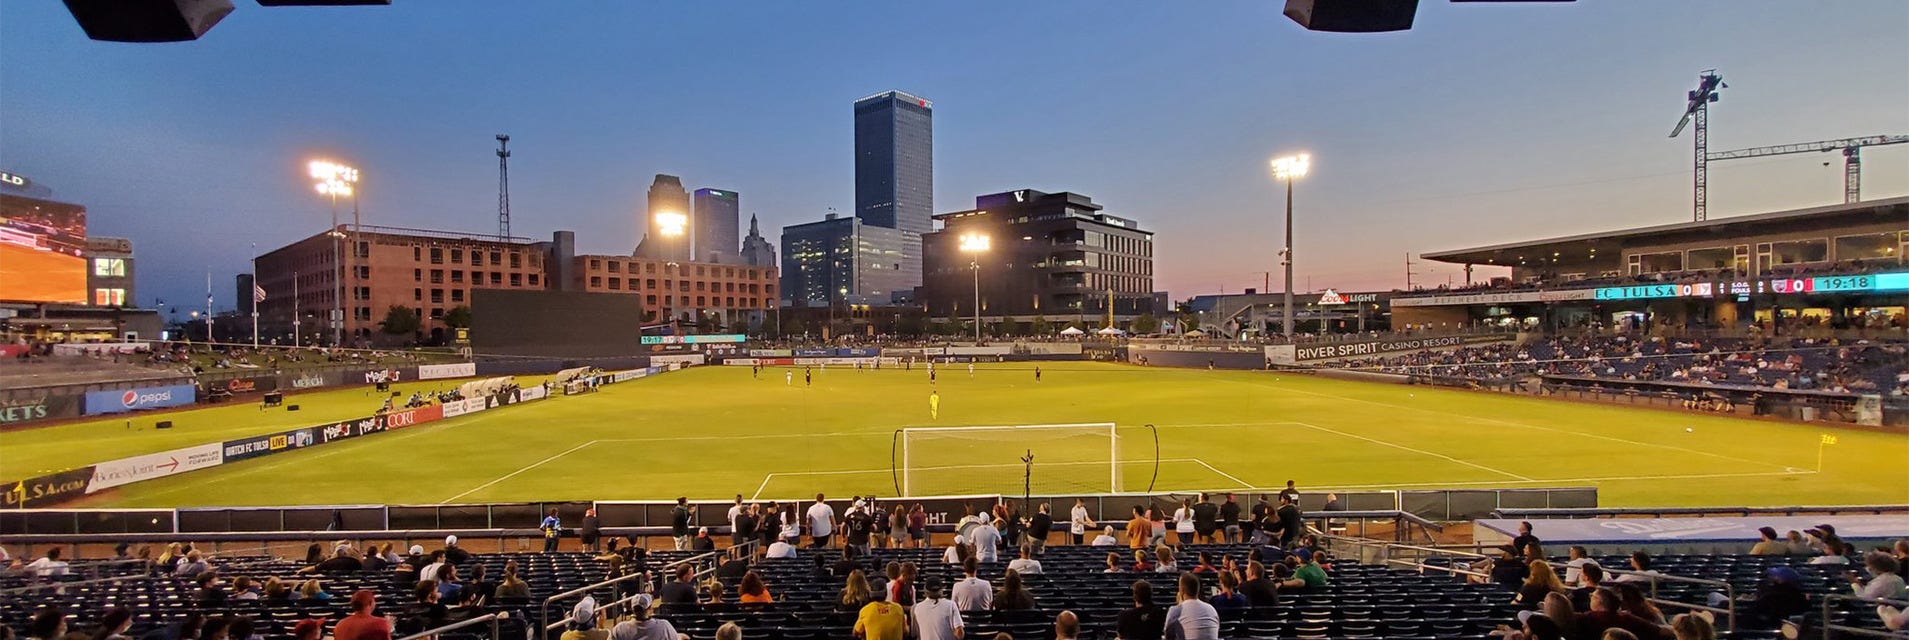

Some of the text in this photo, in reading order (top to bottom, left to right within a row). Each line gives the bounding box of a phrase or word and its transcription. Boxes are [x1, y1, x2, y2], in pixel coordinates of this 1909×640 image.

[0, 172, 23, 185] LD
[1793, 280, 1804, 291] 0
[1824, 277, 1869, 289] 19:18
[1492, 294, 1522, 302] DECK
[1595, 285, 1692, 299] FC TULSA 0
[1321, 294, 1376, 304] Coors LIGHT
[1298, 346, 1333, 360] RIVER
[1338, 342, 1377, 357] SPIRIT
[1381, 340, 1420, 350] CASINO
[1423, 336, 1461, 347] RESORT
[140, 391, 171, 404] pepsi
[387, 410, 416, 430] CORT
[225, 443, 245, 457] WATCH
[245, 442, 253, 453] FC
[253, 440, 269, 451] TULSA
[272, 437, 285, 448] LIVE
[0, 479, 84, 505] ULSA.COM
[927, 512, 947, 524] HT
[852, 520, 863, 531] 16
